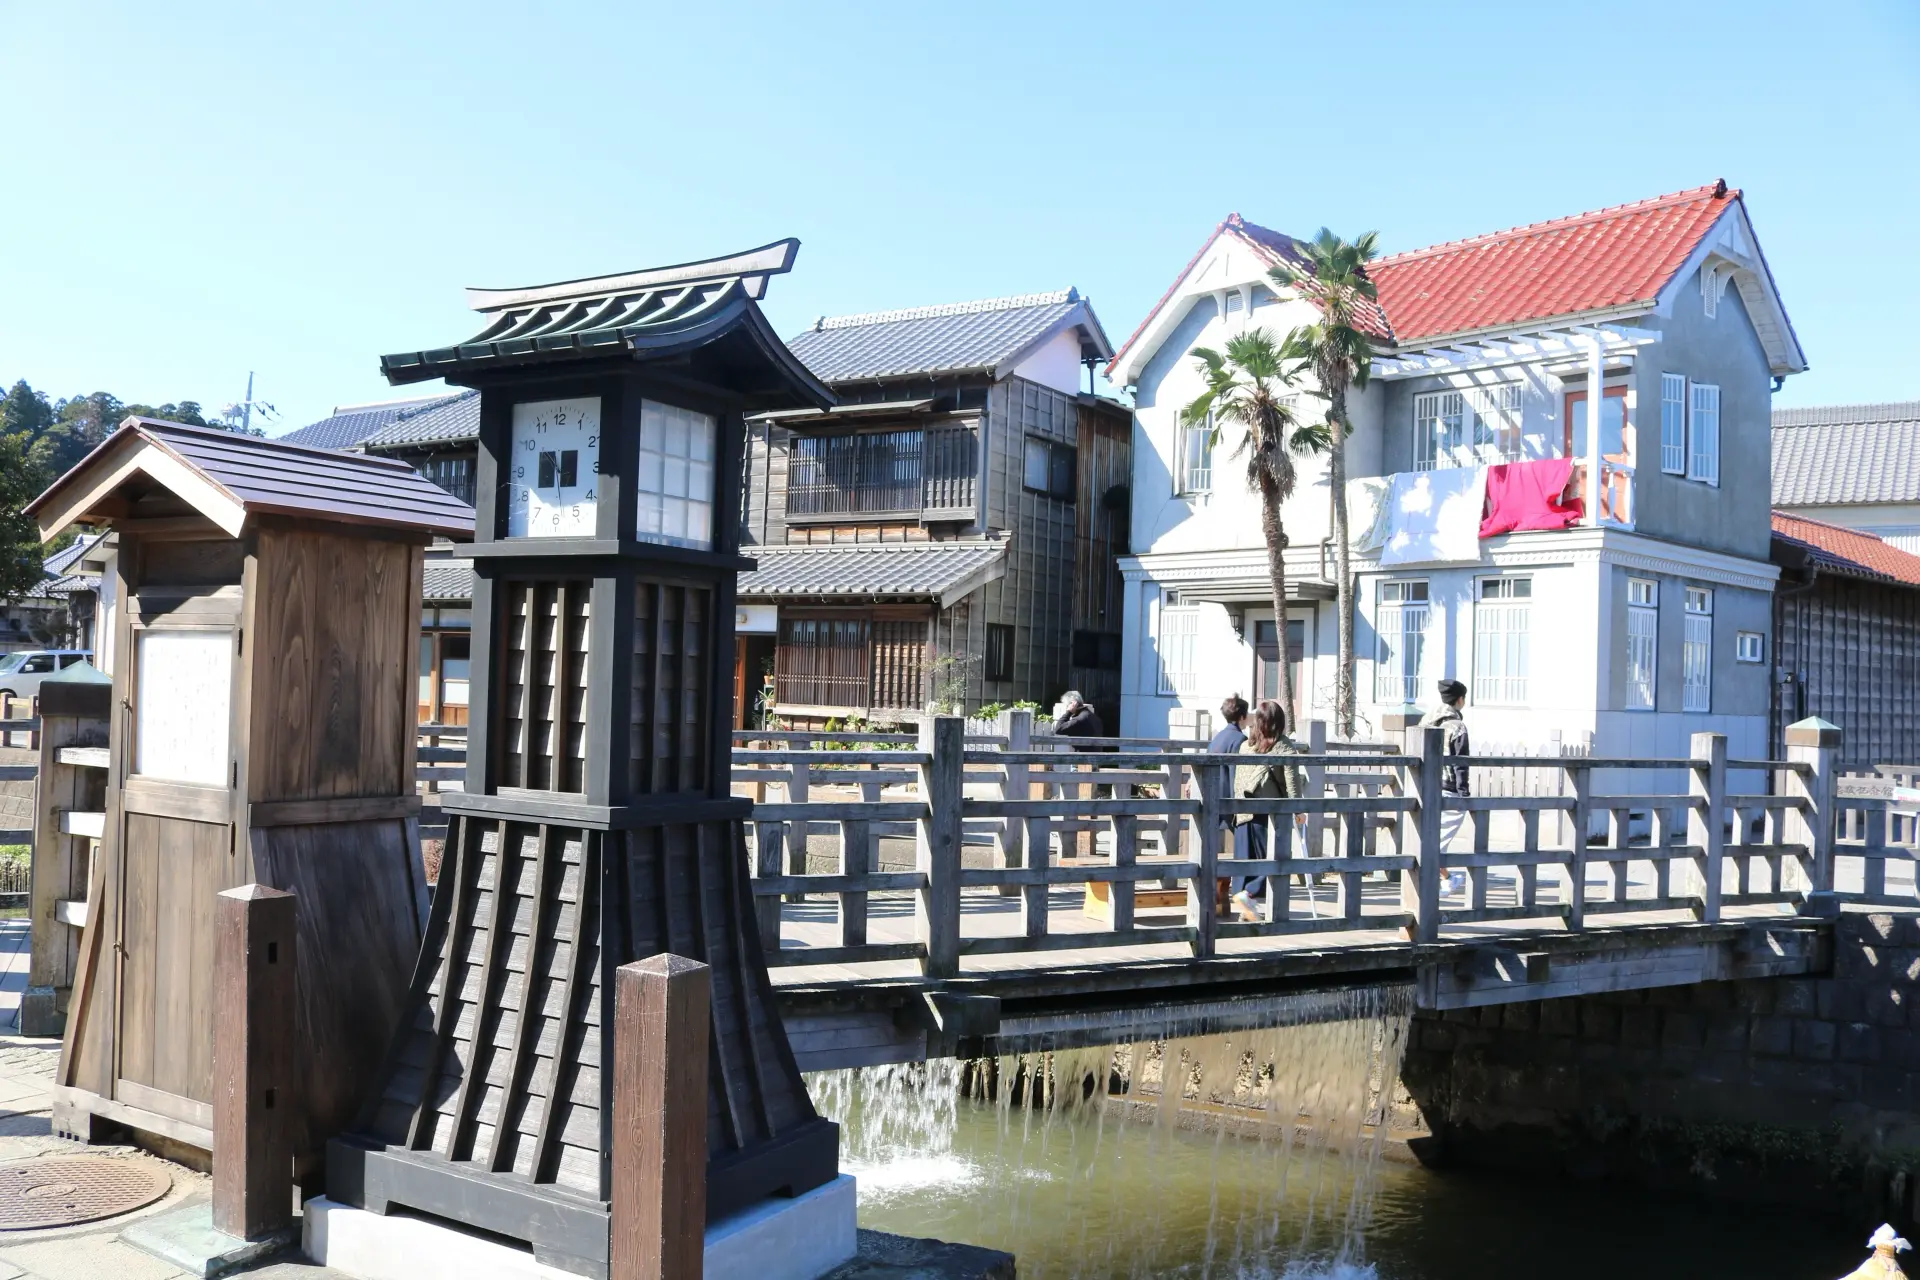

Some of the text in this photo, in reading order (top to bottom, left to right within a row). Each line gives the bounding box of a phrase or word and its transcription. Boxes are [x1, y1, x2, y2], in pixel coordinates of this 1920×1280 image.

[553, 413, 566, 425] 12
[577, 419, 582, 430] 1
[536, 421, 547, 434] 11
[524, 439, 536, 451] 10
[588, 435, 596, 447] 2
[517, 466, 525, 478] 9
[521, 490, 529, 502] 8
[585, 488, 593, 500] 4
[533, 506, 542, 518] 7
[572, 505, 580, 517] 5
[552, 513, 560, 525] 6
